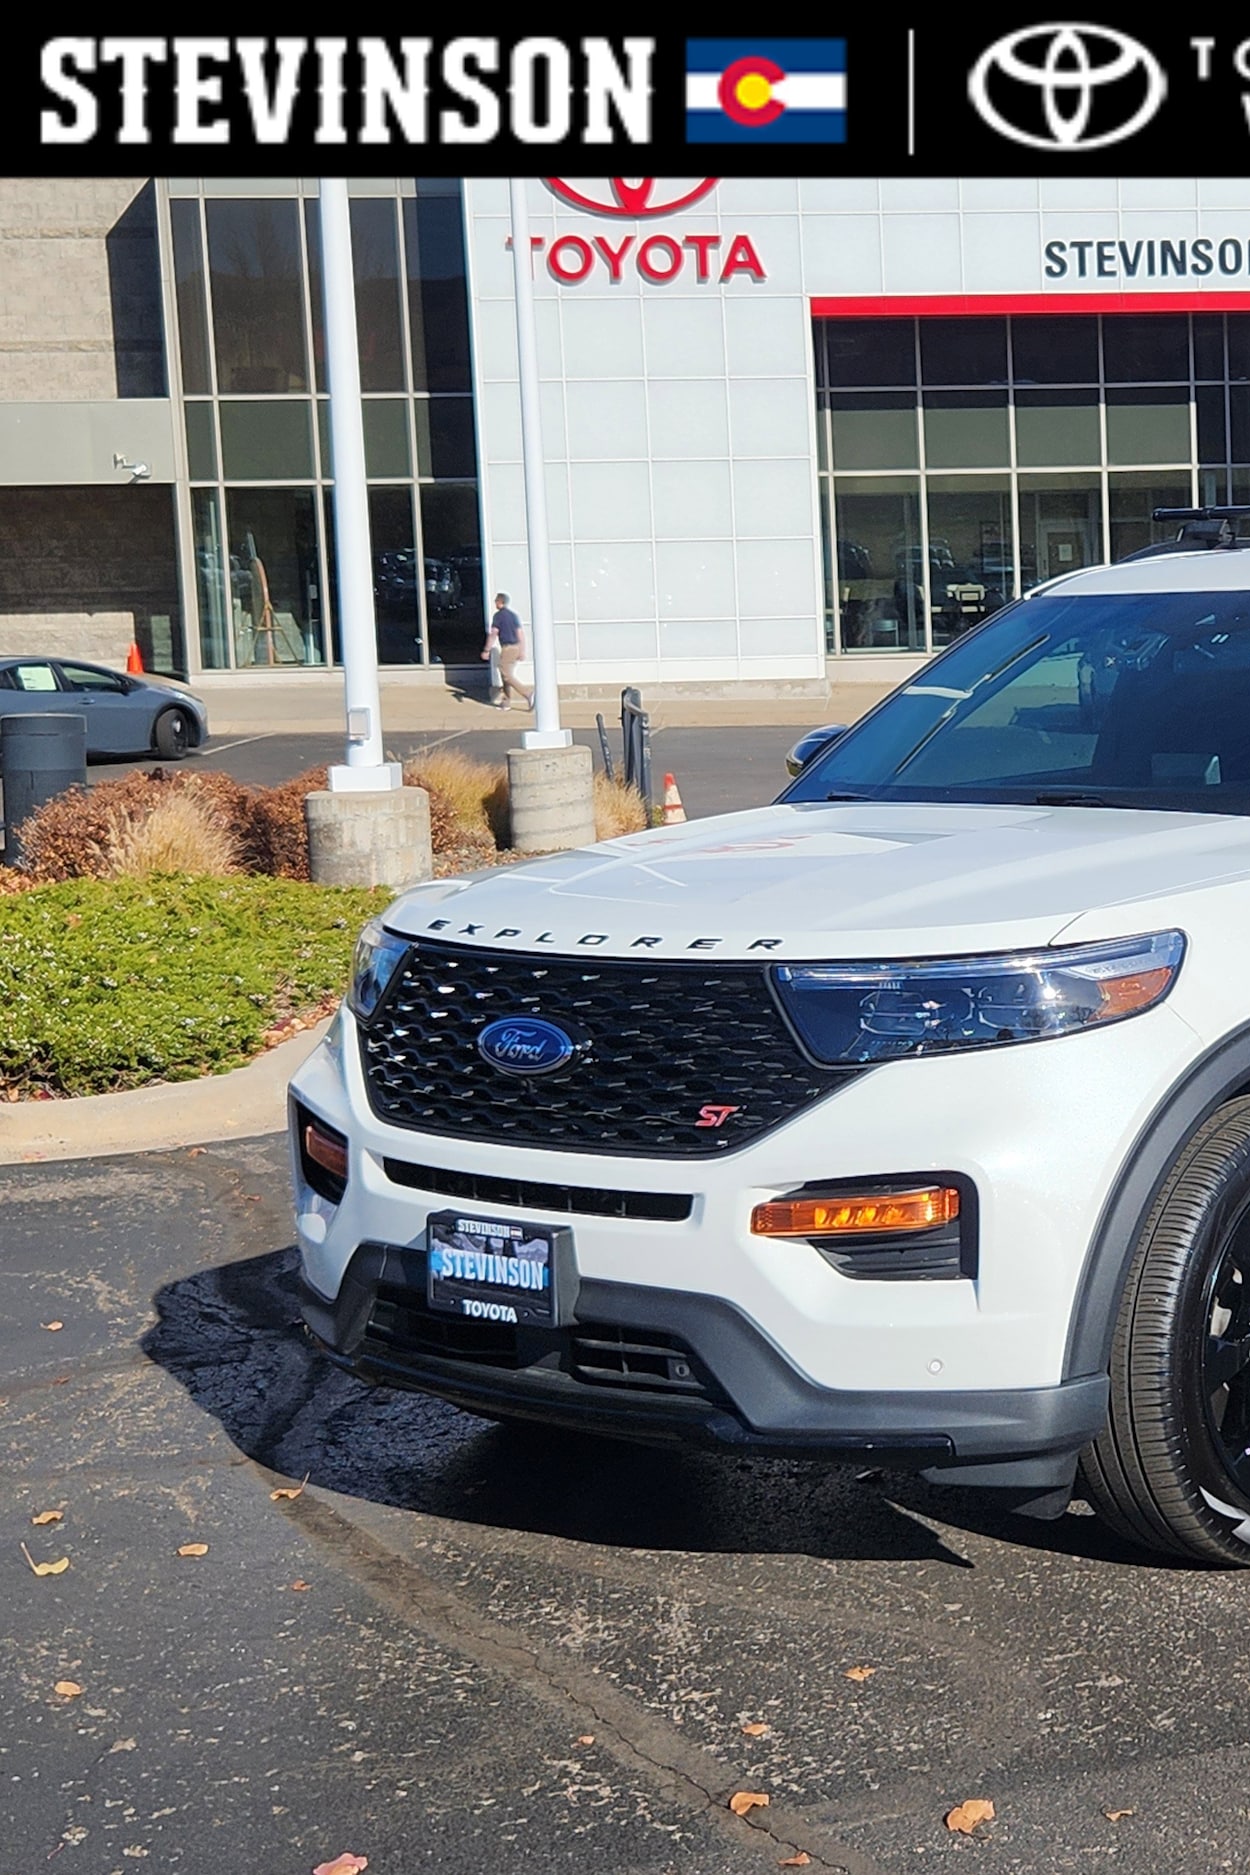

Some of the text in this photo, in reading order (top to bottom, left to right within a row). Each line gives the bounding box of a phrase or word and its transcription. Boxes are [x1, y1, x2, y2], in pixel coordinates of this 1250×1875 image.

[426, 918, 785, 952] EXPLORER
[494, 1027, 548, 1063] Ford
[695, 1104, 741, 1128] ST
[457, 1218, 511, 1239] STEVINSON
[441, 1248, 544, 1291] STEVINSON
[462, 1299, 518, 1324] TOYOTA
